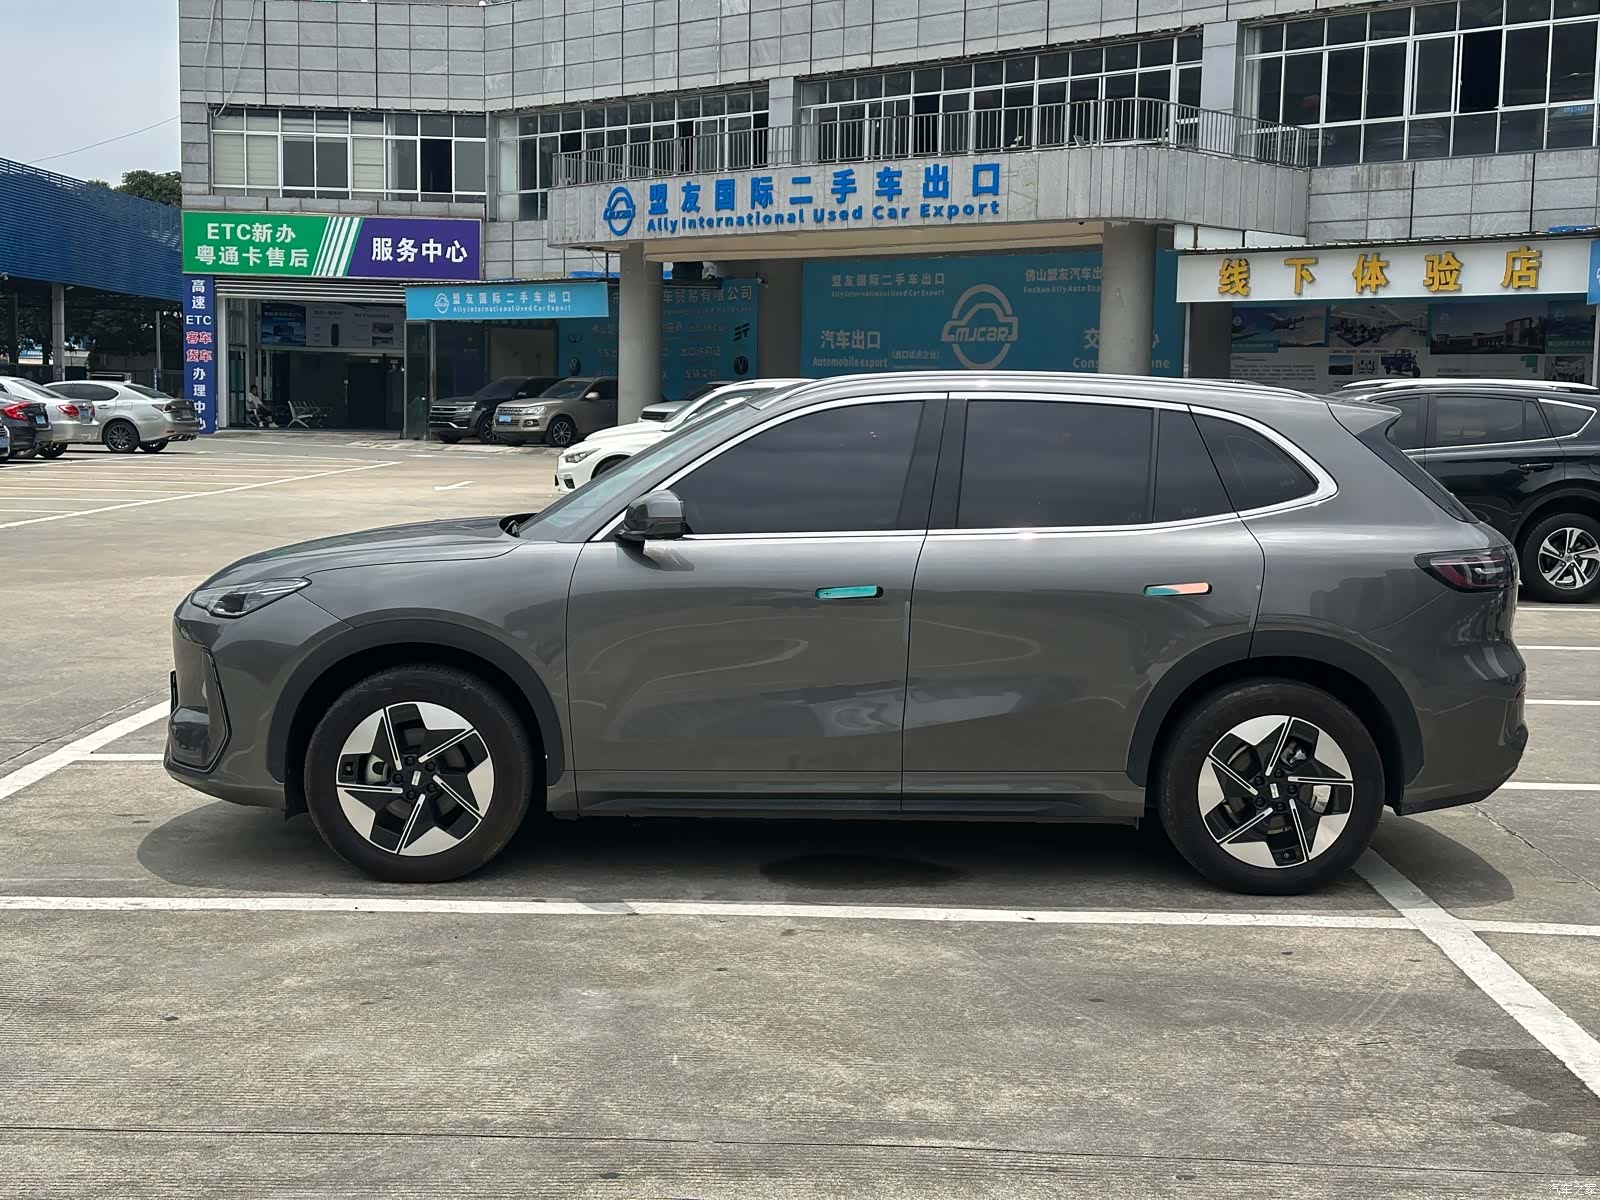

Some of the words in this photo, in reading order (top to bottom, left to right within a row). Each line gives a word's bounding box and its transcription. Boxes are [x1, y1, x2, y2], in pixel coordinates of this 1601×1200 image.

[648, 163, 1000, 216] 盟友国际二手车出口
[647, 216, 678, 234] Ally
[682, 208, 804, 230] International
[813, 206, 863, 223] Used
[872, 205, 910, 220] Car
[920, 201, 1000, 220] Export
[207, 222, 296, 243] ETC新办
[195, 245, 310, 267] 粤通卡售后
[371, 237, 468, 263] 服务中心
[832, 272, 945, 287] 盟友国际二手车出口
[1218, 246, 1543, 297] 线下体验店
[191, 279, 206, 309] 高速
[452, 291, 571, 305] 盟友国际二手车出口
[547, 304, 571, 312] Export
[186, 315, 212, 325] ETC
[186, 331, 212, 344] 客车
[821, 330, 881, 349] 汽车出口
[186, 349, 212, 362] 货车
[813, 356, 858, 367] Automobile
[860, 357, 888, 368] export
